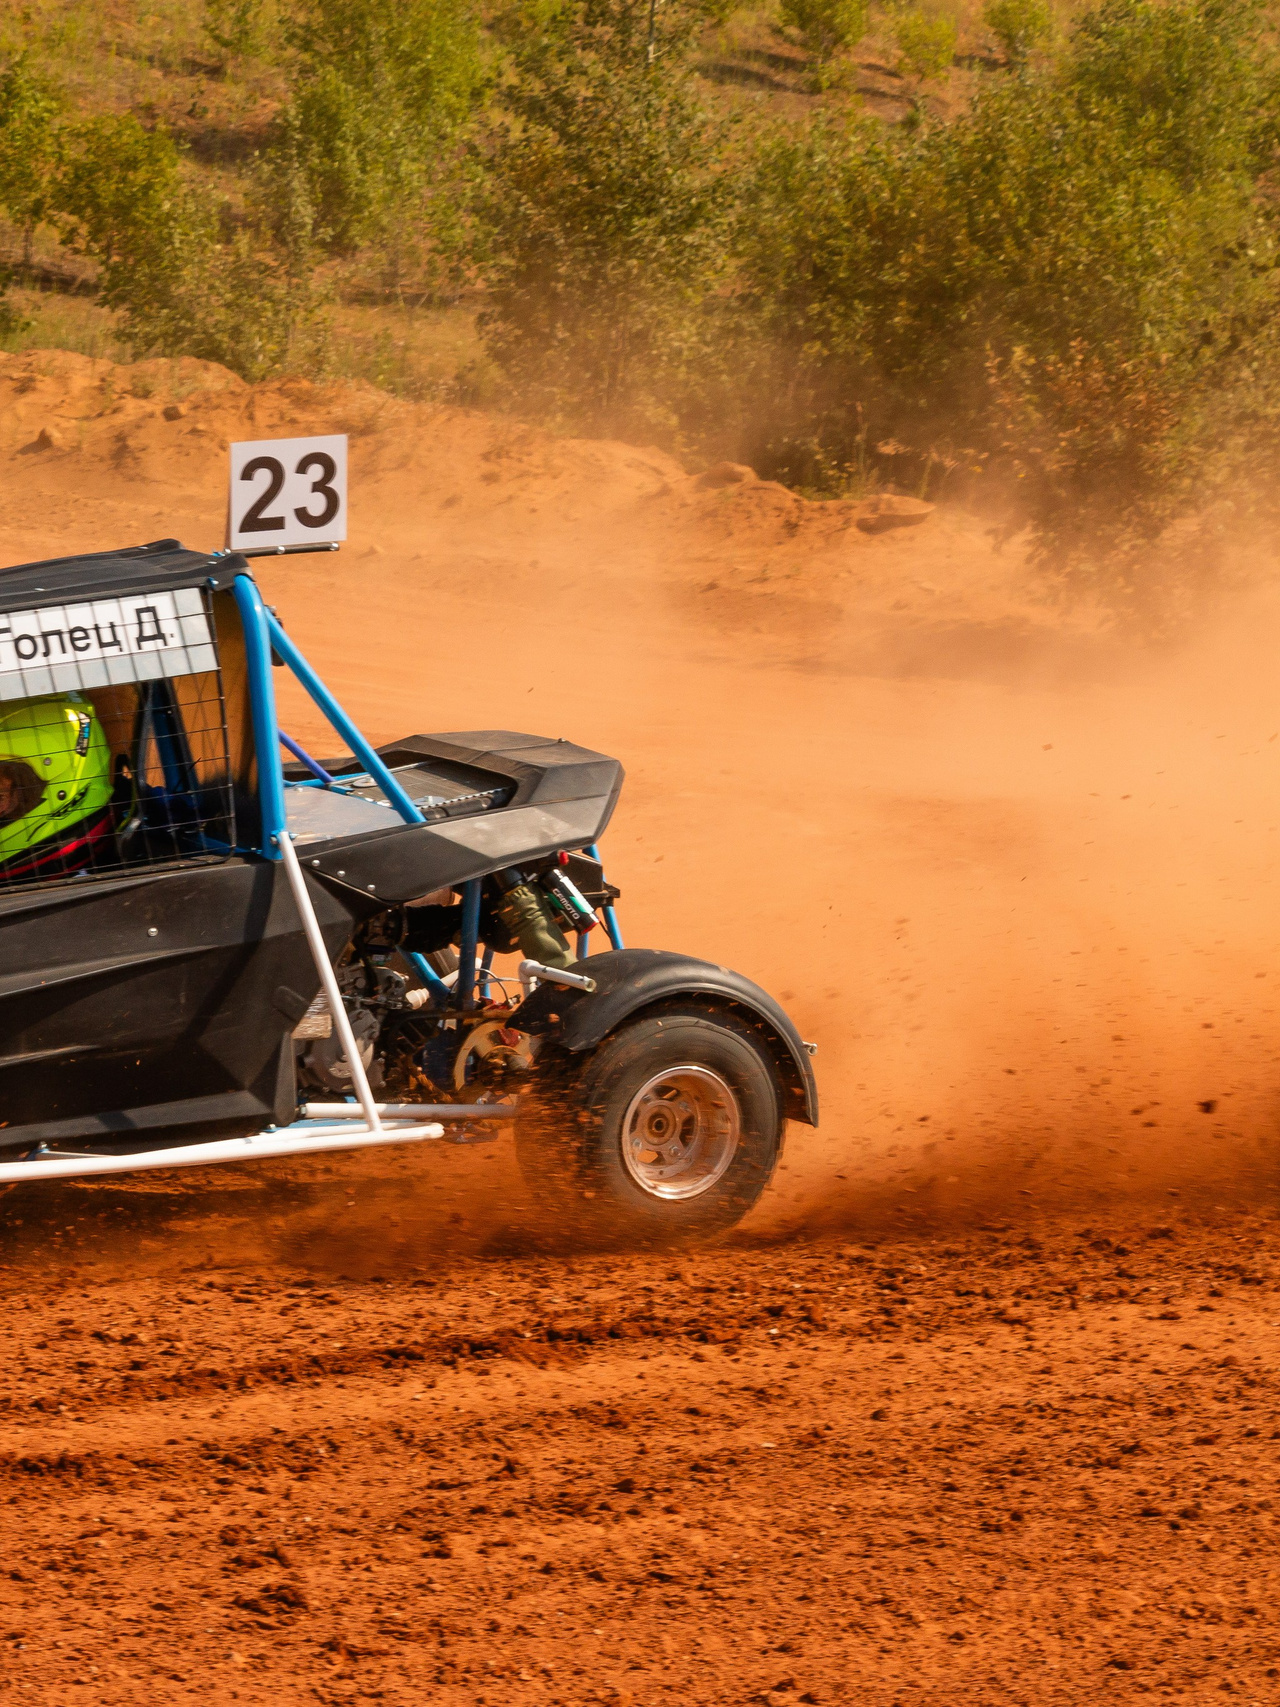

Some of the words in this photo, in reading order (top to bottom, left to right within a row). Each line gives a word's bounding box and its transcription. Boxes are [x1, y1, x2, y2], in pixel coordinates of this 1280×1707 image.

[239, 452, 340, 533] 23
[135, 606, 174, 650] Д.
[552, 888, 580, 920] CFMOTO
